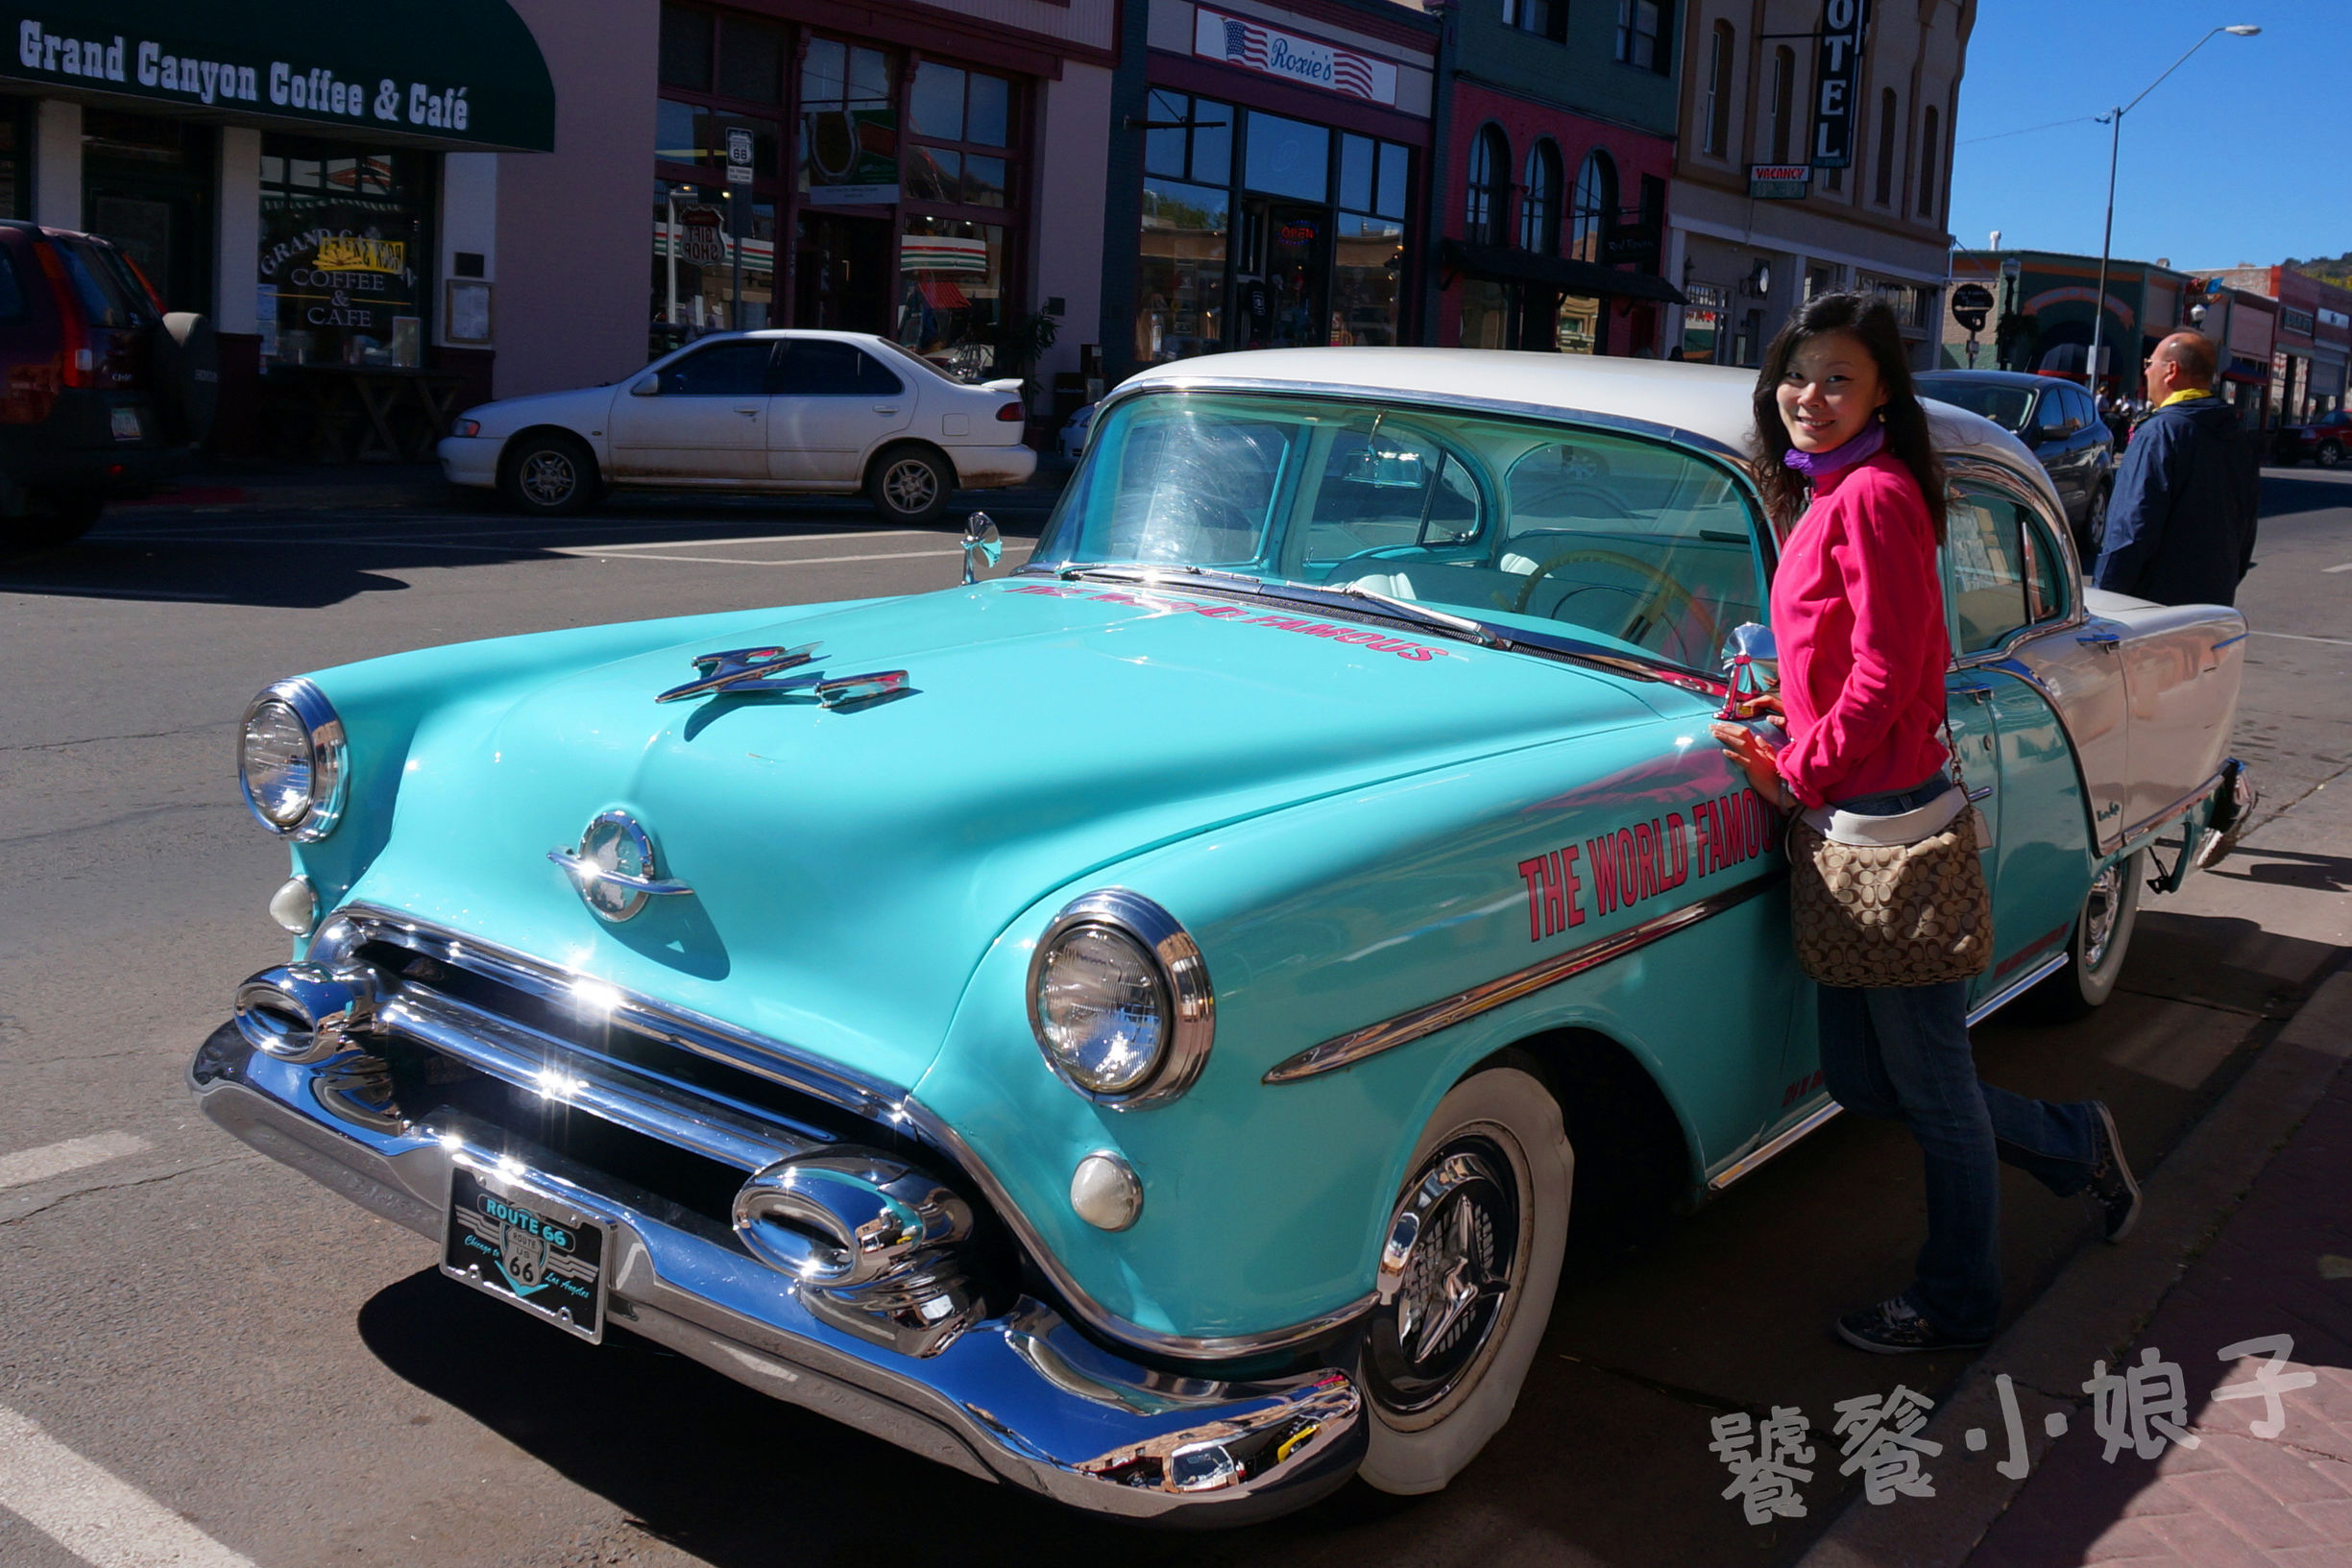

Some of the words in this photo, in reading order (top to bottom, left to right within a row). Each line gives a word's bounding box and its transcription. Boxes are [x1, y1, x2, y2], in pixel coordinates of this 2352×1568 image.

[1271, 37, 1332, 81] Roxie's
[19, 19, 126, 82] Grand
[137, 40, 257, 104] Canyon
[270, 60, 362, 116] Coffee
[374, 79, 400, 121] &
[409, 82, 469, 131] Café
[1817, 0, 1855, 157] OTEL
[733, 149, 747, 159] 66
[1756, 167, 1806, 180] VACANCY
[1281, 226, 1314, 239] OPEN
[260, 228, 332, 277] GRAND
[291, 268, 386, 291] COFFEE
[331, 289, 352, 307] &
[306, 306, 373, 327] CAFE
[1248, 614, 1450, 663] FAMOUS
[1517, 844, 1586, 943] THE
[1586, 811, 1690, 917] WORLD
[1691, 787, 1775, 879] FAMOU
[486, 1198, 539, 1235] ROUTE
[542, 1225, 567, 1246] 66
[513, 1232, 537, 1249] ROUTE
[509, 1256, 534, 1283] 66
[545, 1272, 560, 1287] Los
[560, 1280, 589, 1299] Angeles
